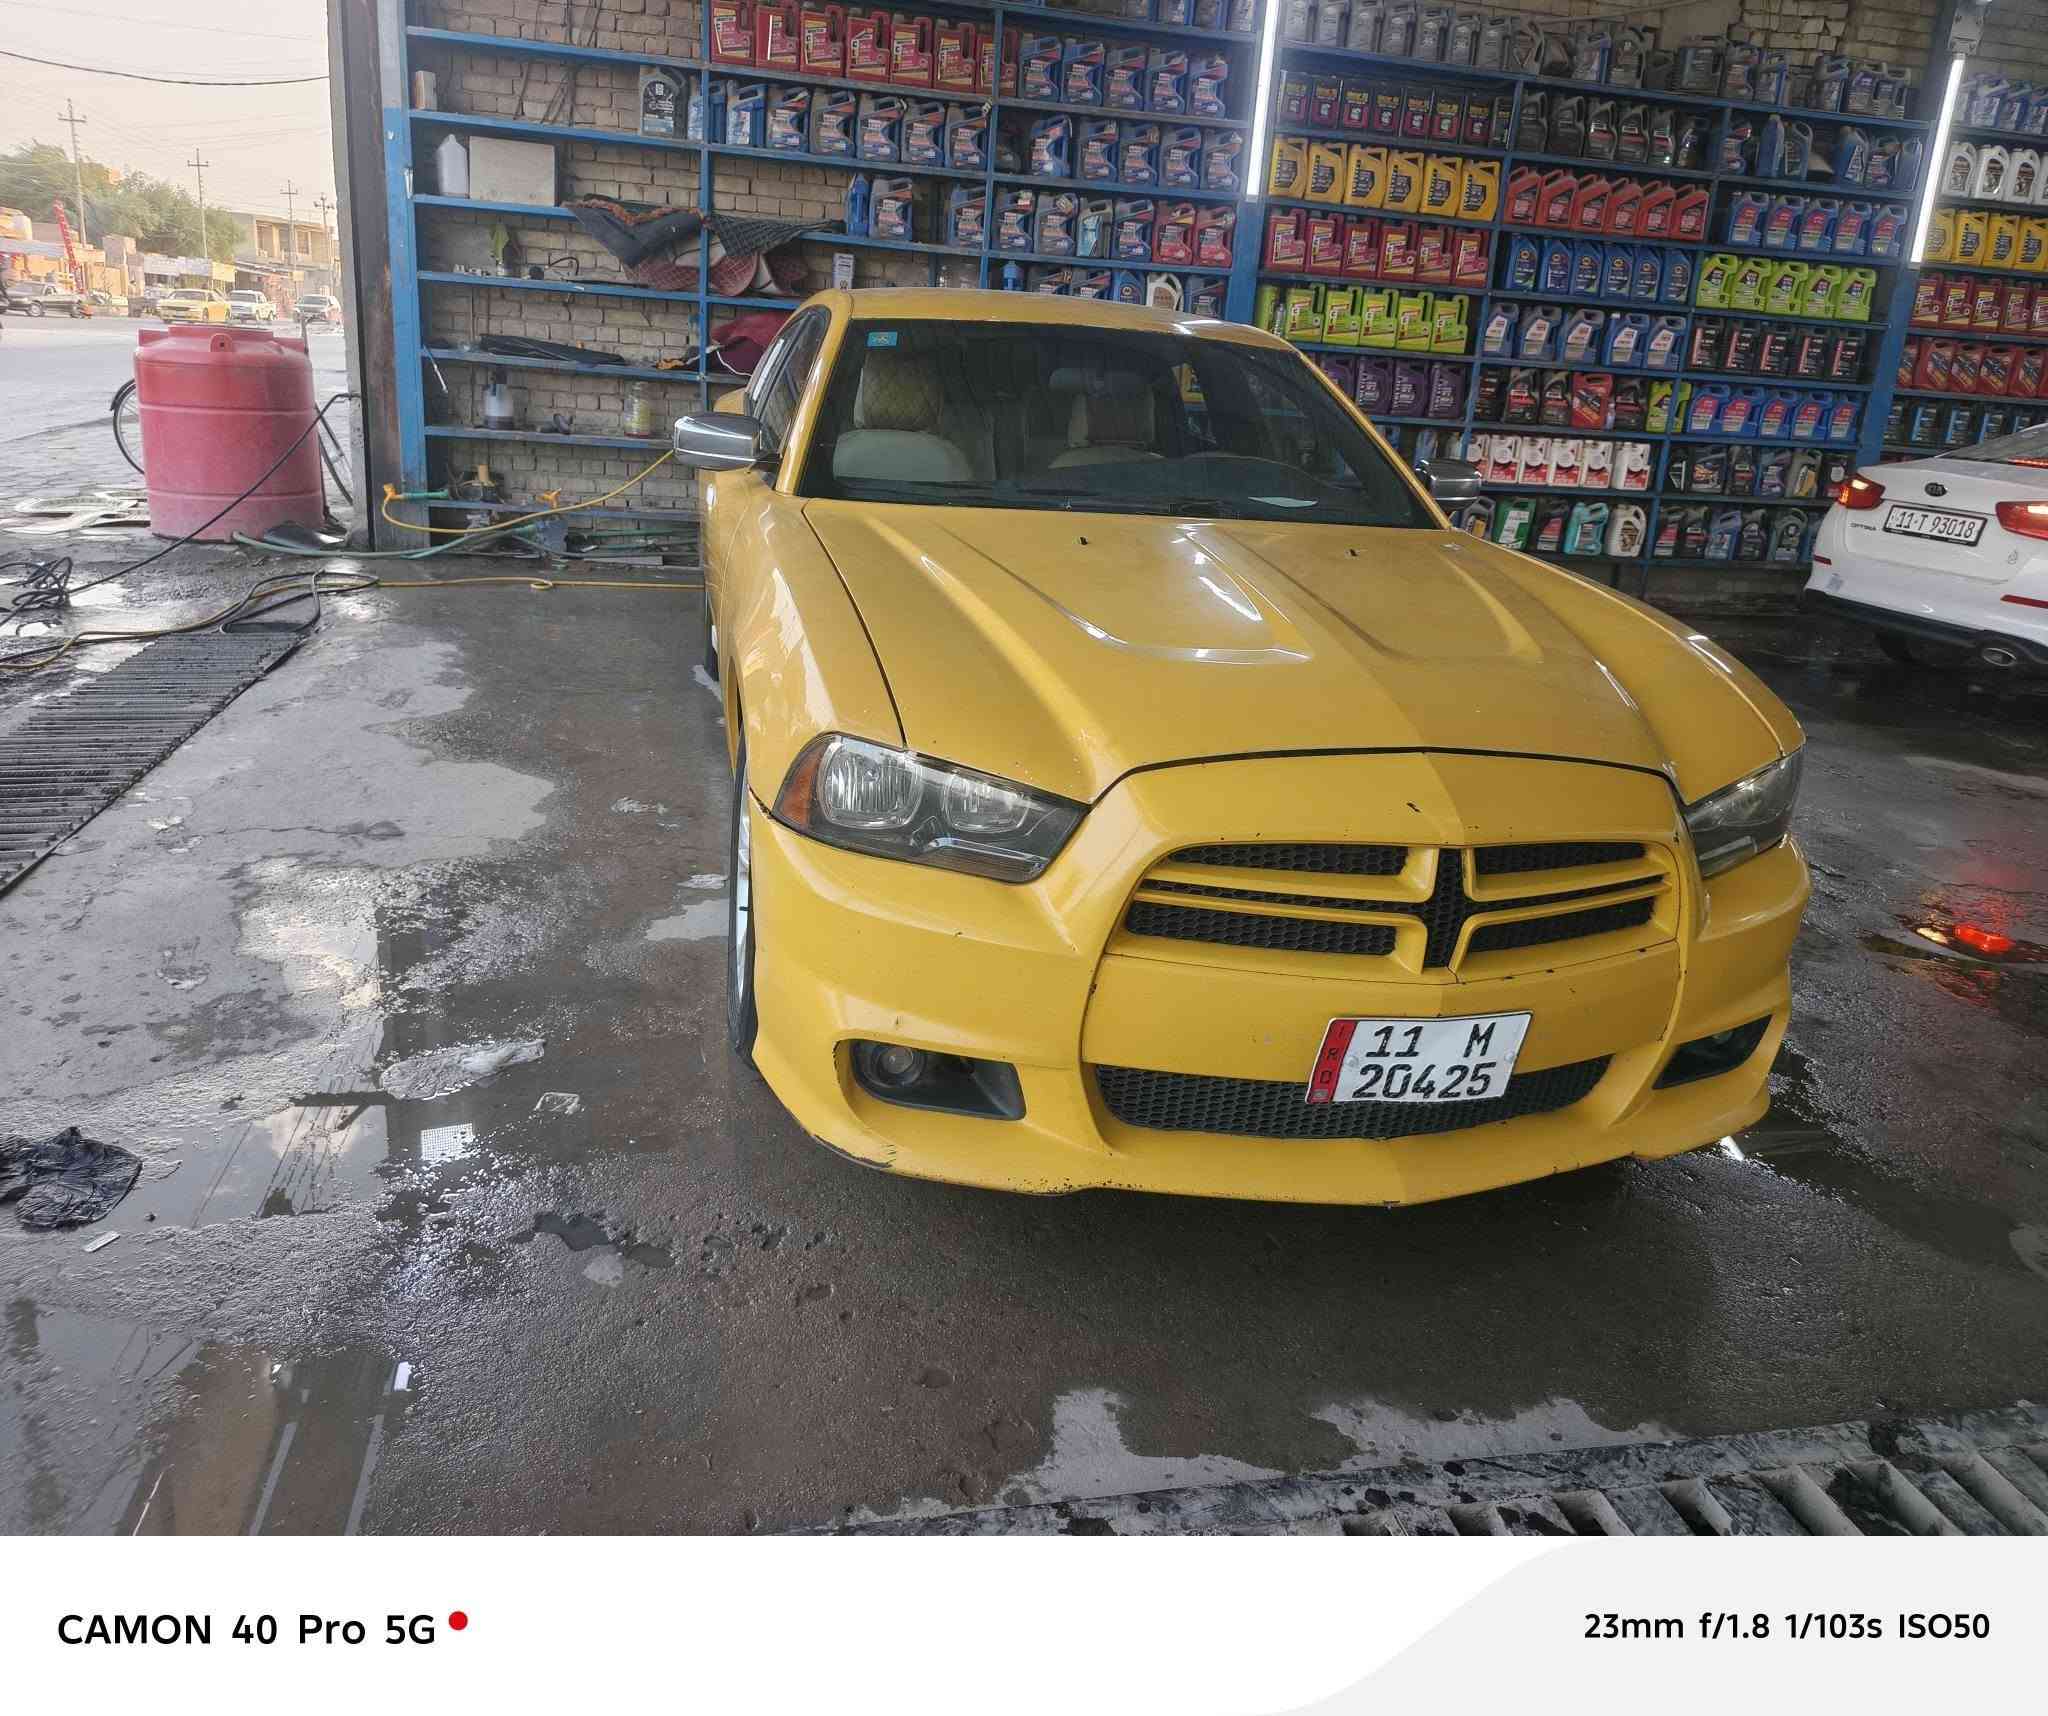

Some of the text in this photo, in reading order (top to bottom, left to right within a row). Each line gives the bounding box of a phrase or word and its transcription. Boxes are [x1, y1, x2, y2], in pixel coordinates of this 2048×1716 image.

[1929, 516, 1976, 539] 93018
[1366, 1021, 1496, 1058] 11 M
[1351, 1061, 1497, 1099] 20425
